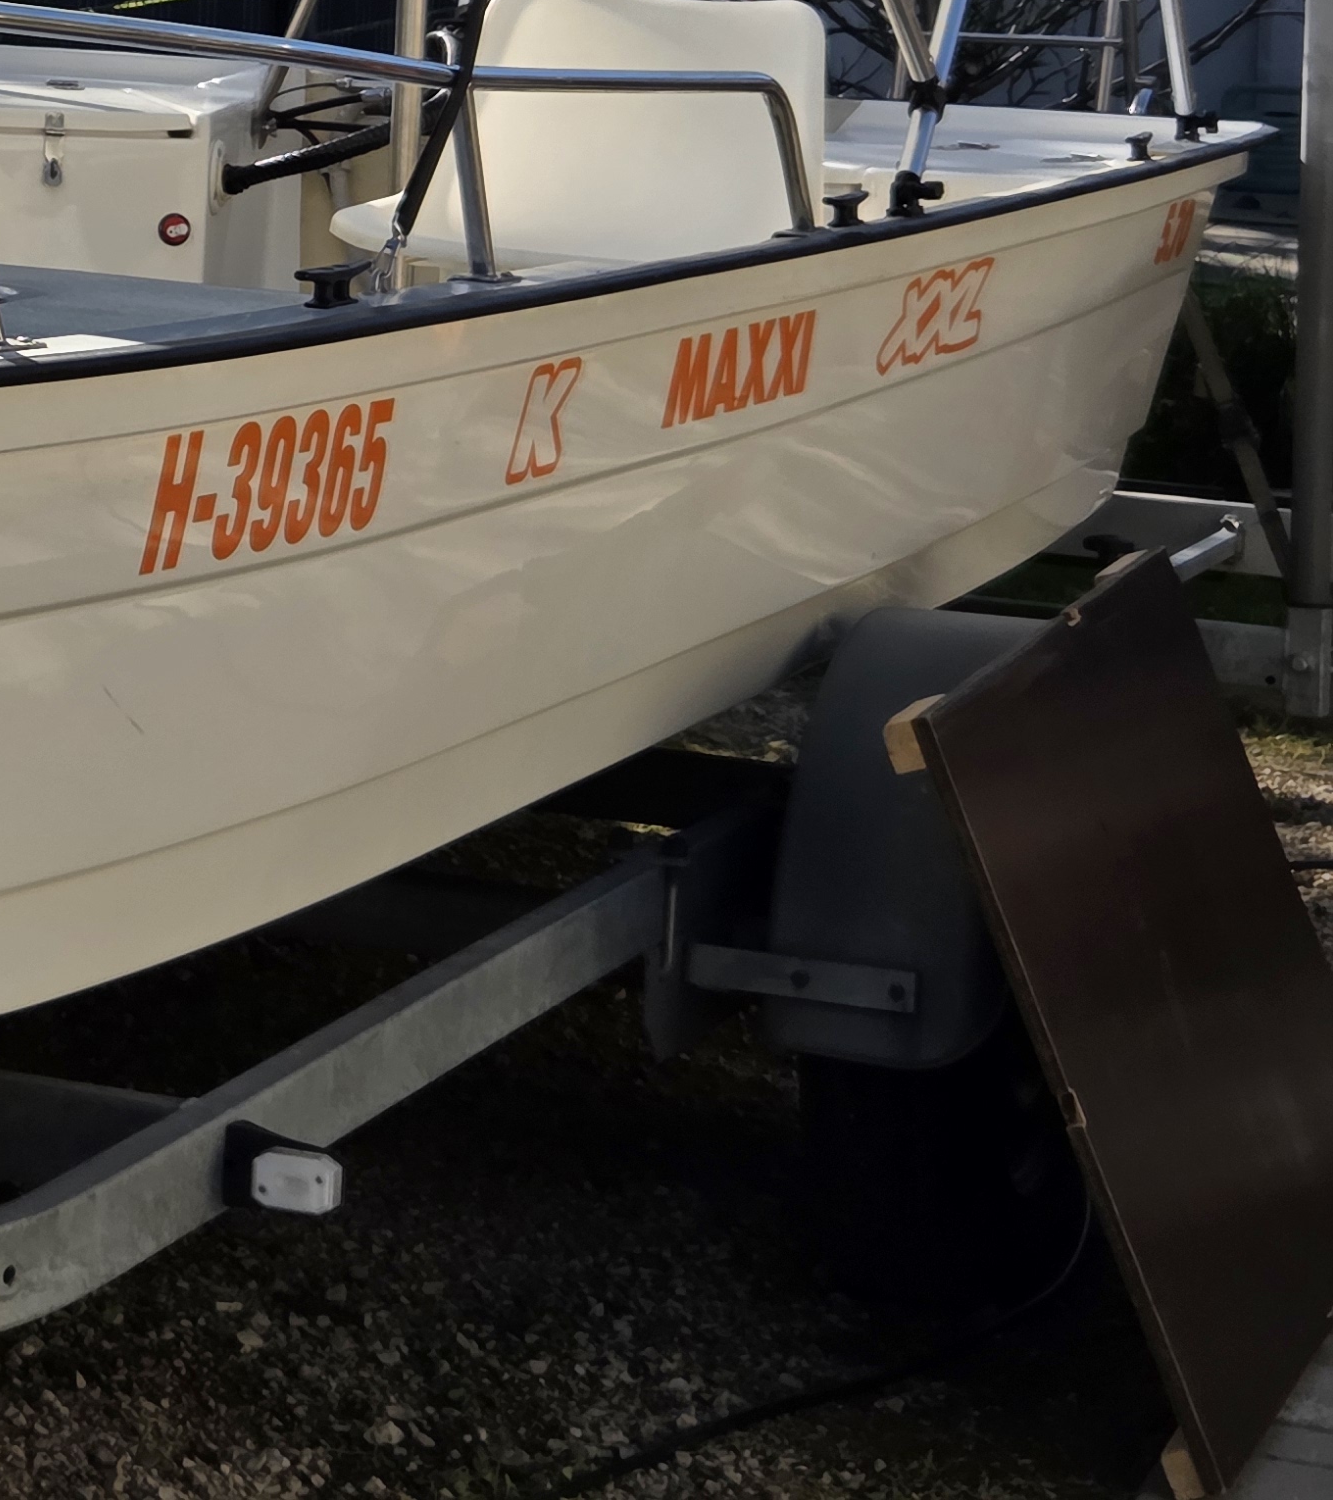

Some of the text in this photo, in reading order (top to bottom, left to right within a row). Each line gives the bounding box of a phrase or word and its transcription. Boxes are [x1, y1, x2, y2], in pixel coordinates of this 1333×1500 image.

[505, 257, 995, 486] K MAXXI XXL
[139, 397, 395, 575] H-39365
